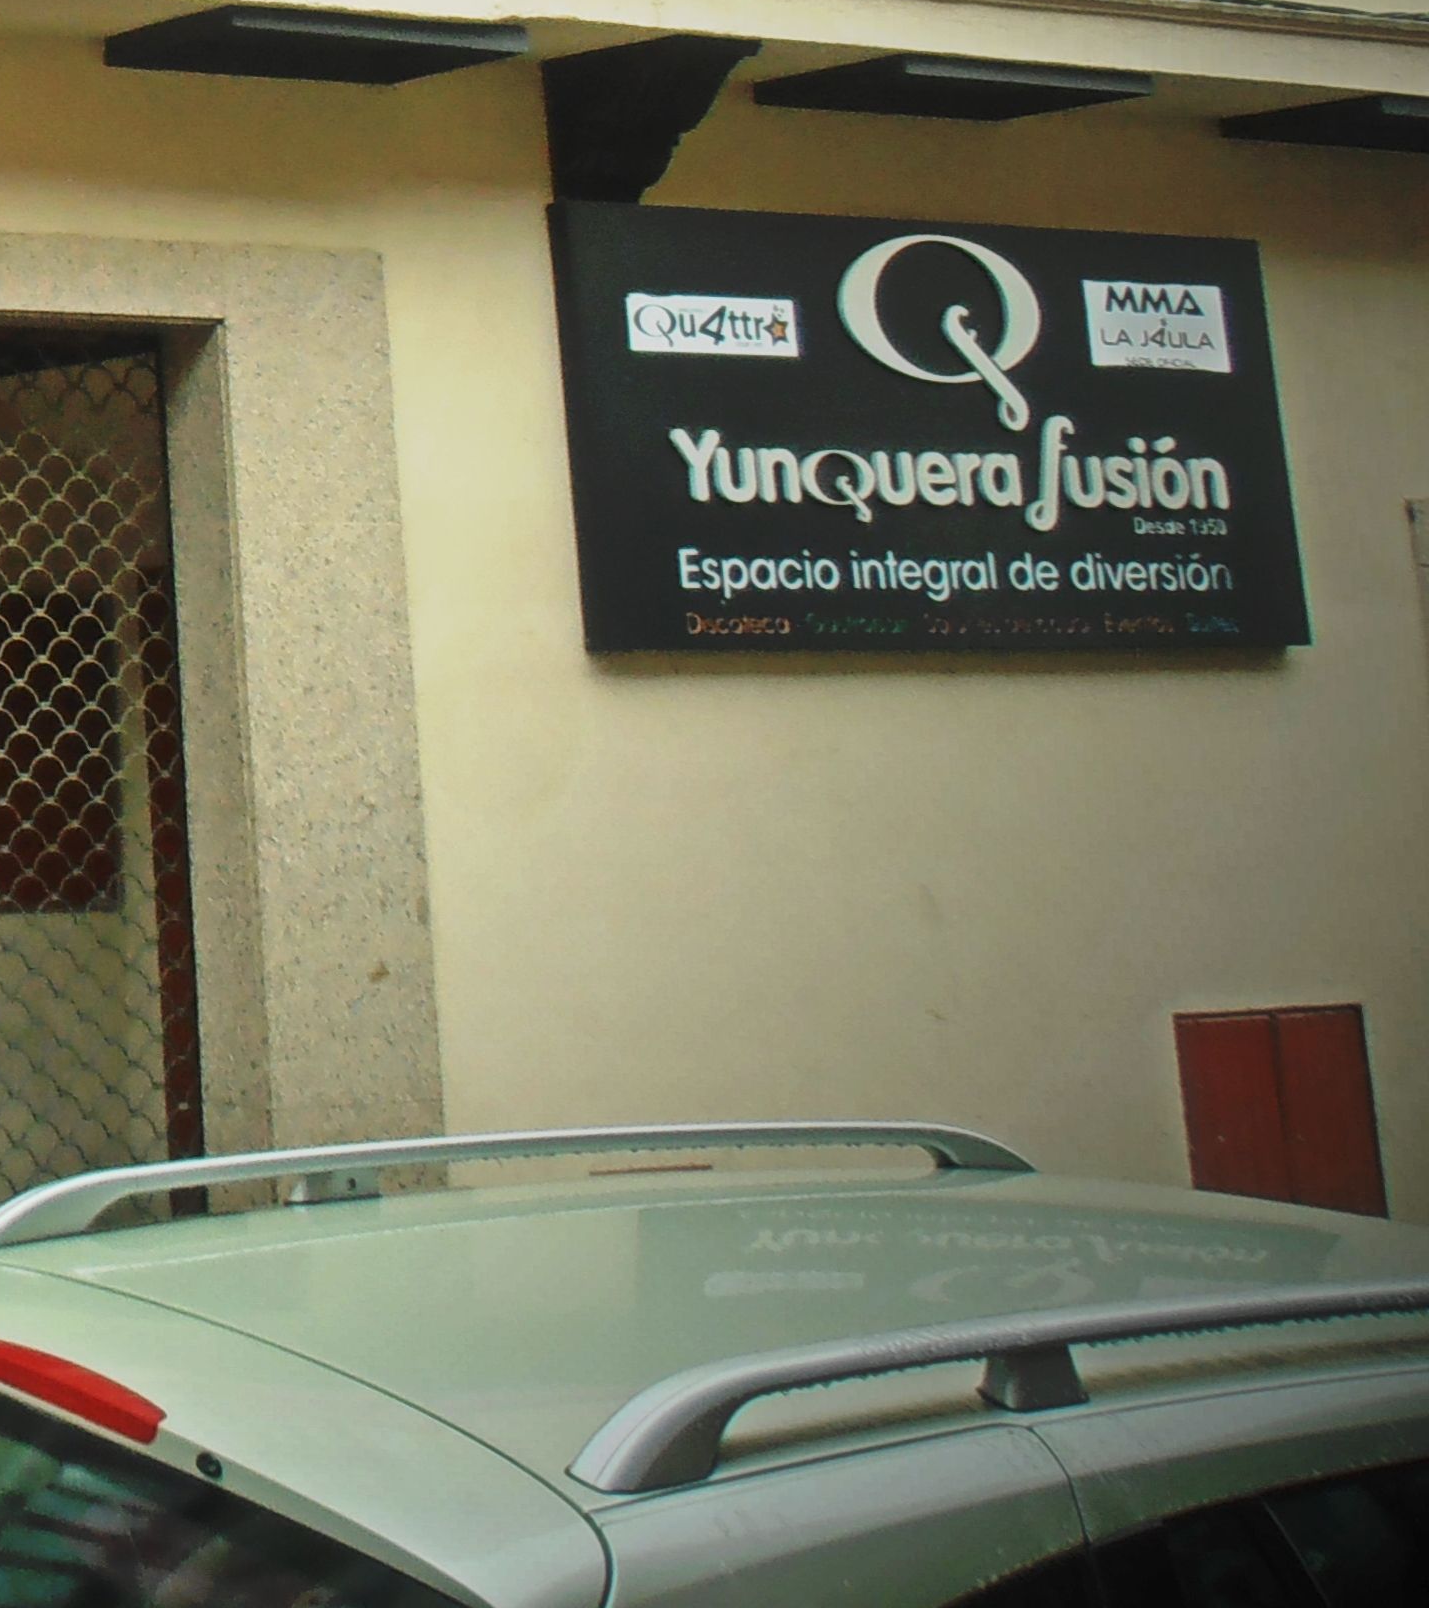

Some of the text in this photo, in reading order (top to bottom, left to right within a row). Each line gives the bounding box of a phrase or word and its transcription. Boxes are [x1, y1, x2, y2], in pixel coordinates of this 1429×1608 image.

[1105, 285, 1206, 317] MMA
[1100, 327, 1134, 347] LA
[1133, 516, 1186, 535] Desde
[677, 547, 1234, 603] Espacio integral de diversión
